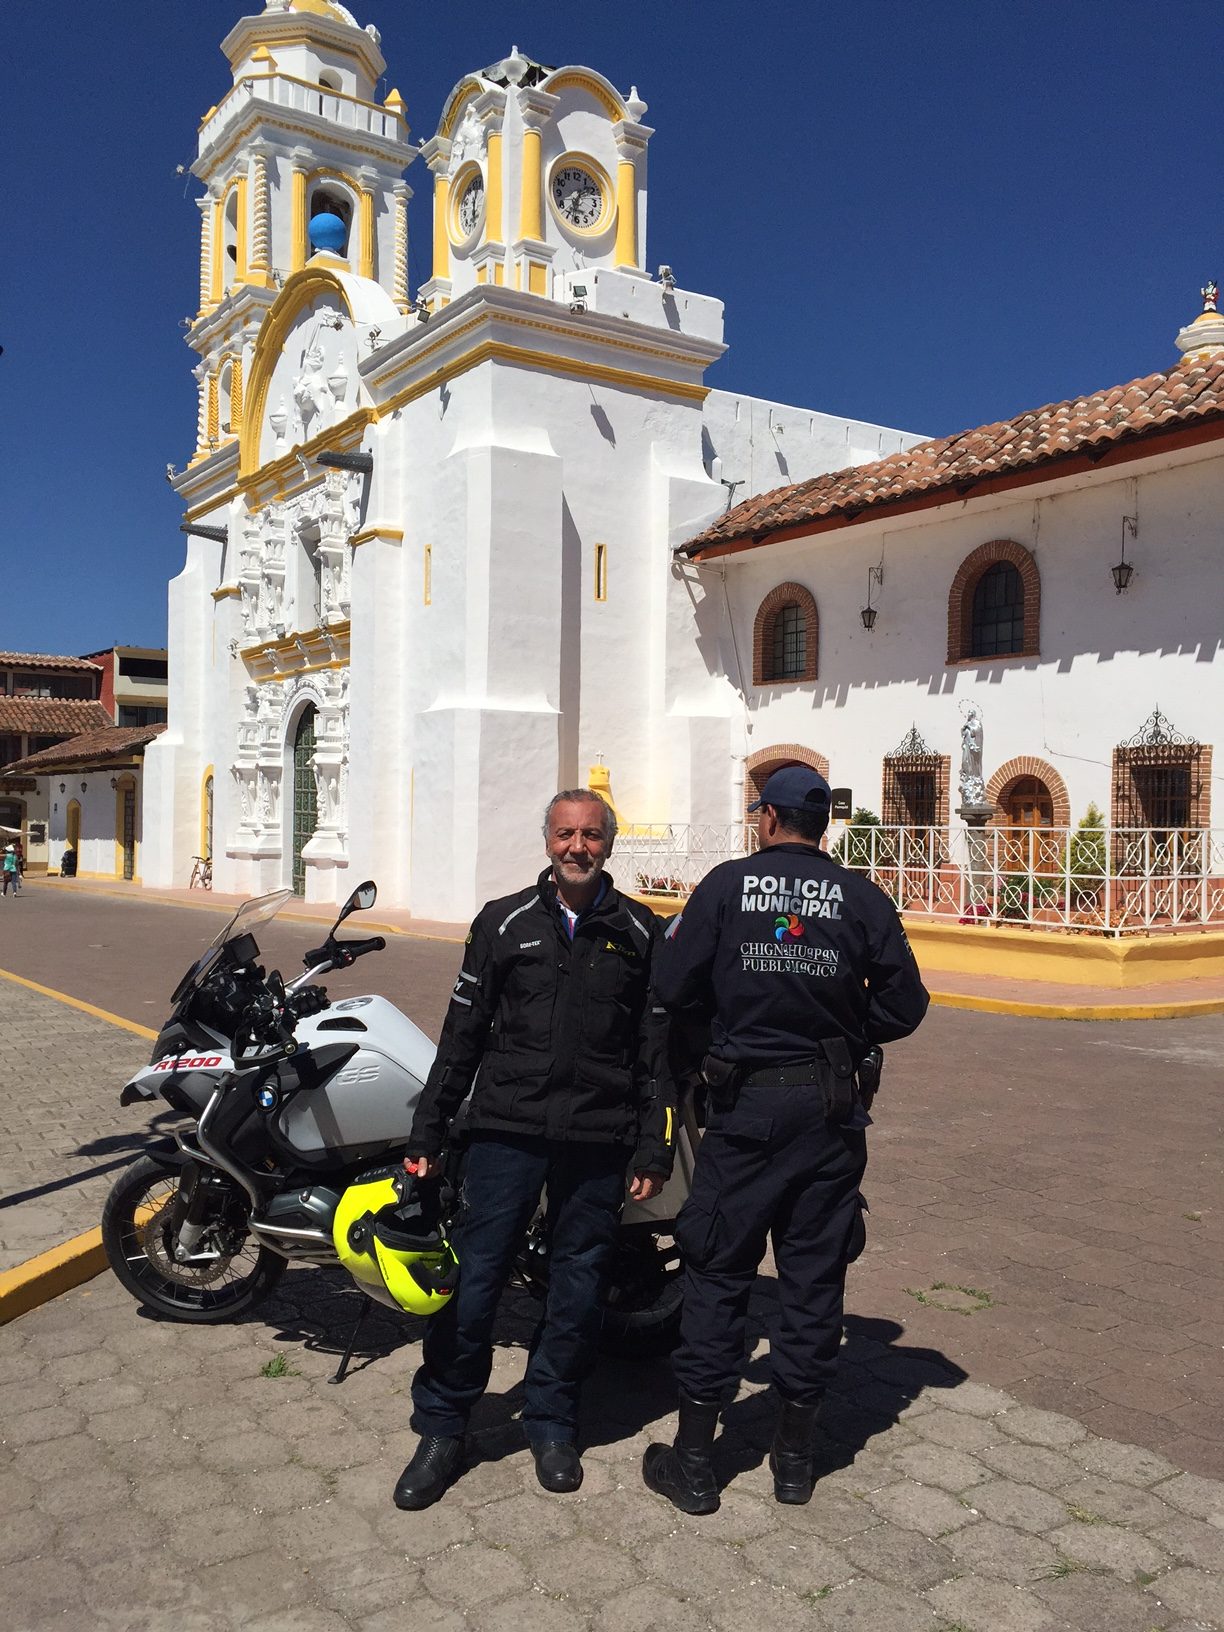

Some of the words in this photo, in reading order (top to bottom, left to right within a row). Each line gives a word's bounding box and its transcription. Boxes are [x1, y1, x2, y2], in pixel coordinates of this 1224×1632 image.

[564, 172, 570, 180] 11
[573, 172, 581, 181] 12
[557, 178, 565, 187] 10
[556, 189, 562, 197] 9
[590, 187, 596, 196] 2
[559, 200, 565, 209] 8
[592, 198, 597, 208] 3
[565, 210, 571, 219] 7
[588, 208, 594, 217] 4
[574, 216, 580, 224] 6
[583, 215, 589, 224] 5
[743, 875, 844, 902] POLICÍA
[741, 894, 842, 920] MUNICIPAL
[153, 1056, 222, 1072] R1200
[336, 1065, 380, 1085] GS
